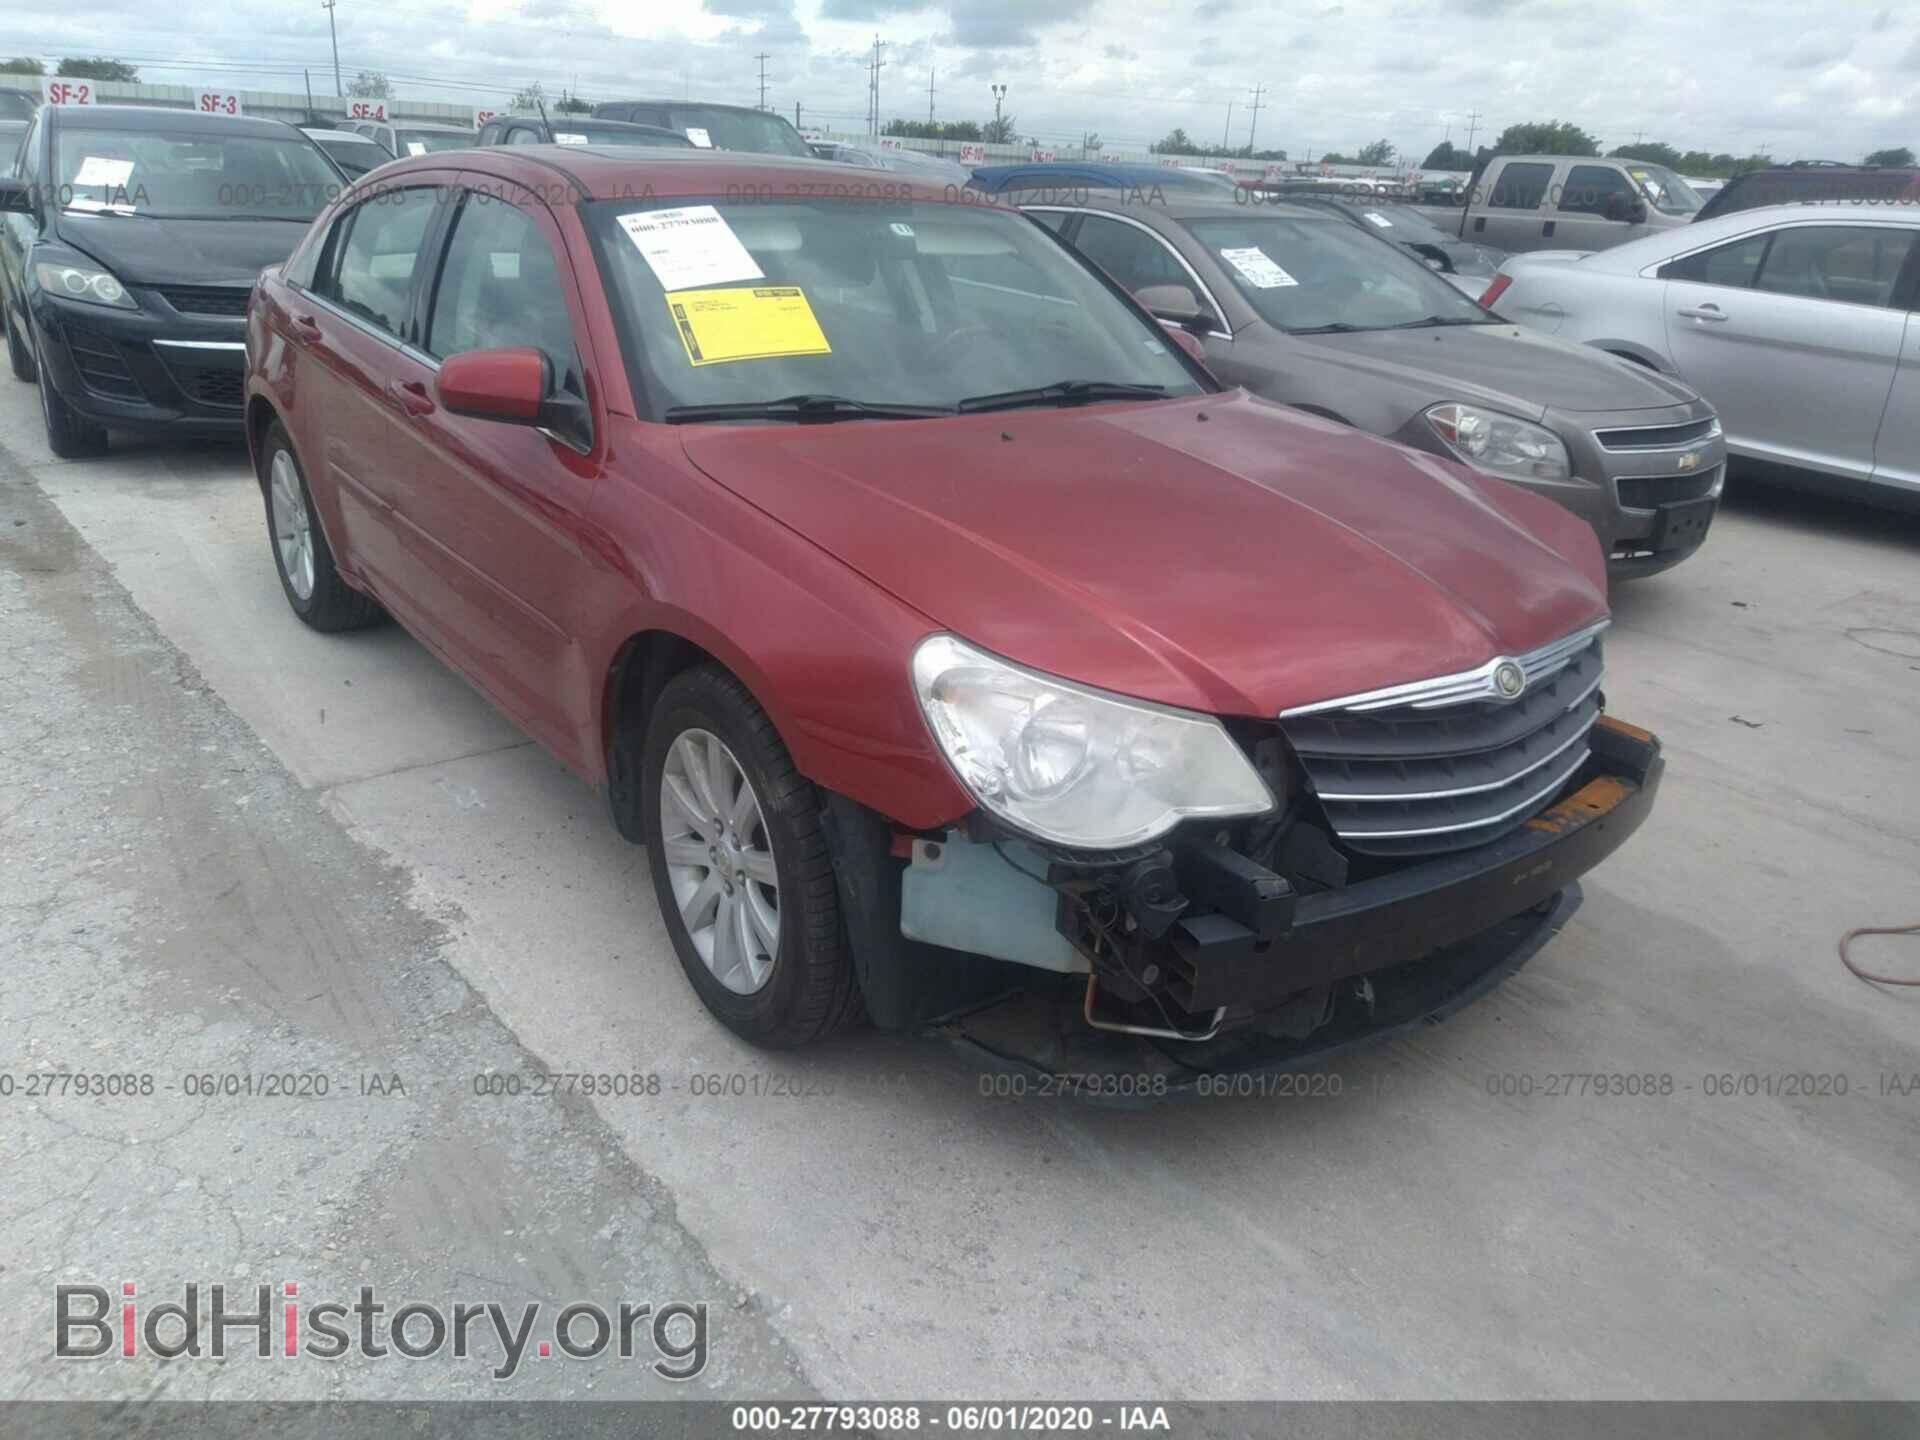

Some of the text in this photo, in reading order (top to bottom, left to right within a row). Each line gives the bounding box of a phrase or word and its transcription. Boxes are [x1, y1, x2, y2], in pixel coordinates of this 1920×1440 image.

[50, 83, 89, 105] SF-2
[201, 94, 237, 115] SF-3
[352, 103, 385, 119] SF-4
